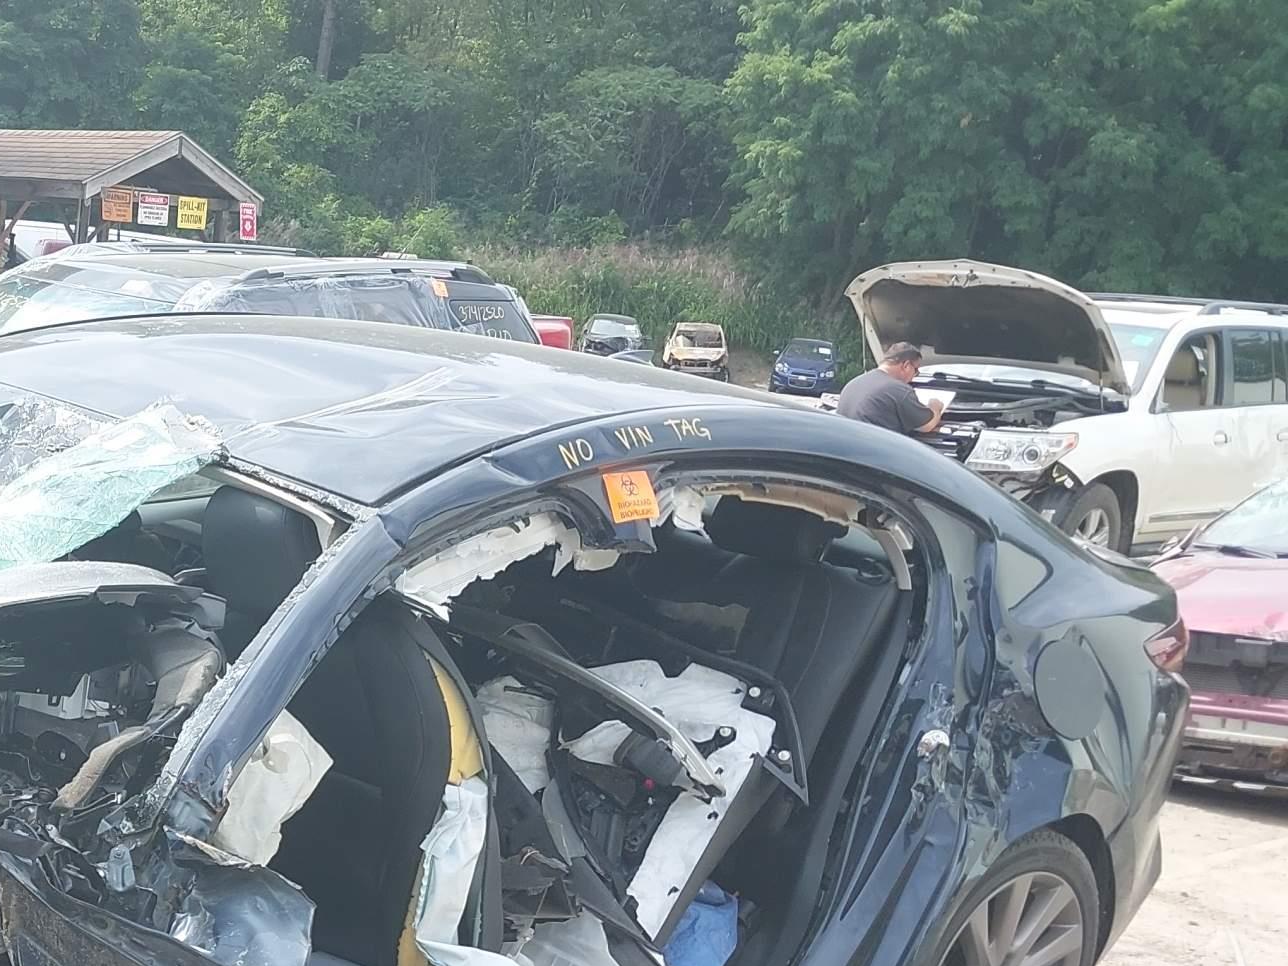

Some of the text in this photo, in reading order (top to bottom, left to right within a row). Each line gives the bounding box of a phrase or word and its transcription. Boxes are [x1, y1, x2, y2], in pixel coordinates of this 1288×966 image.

[179, 200, 206, 212] SPILL-KIT
[180, 213, 203, 225] STATION
[557, 417, 712, 470] NO VIN TAG
